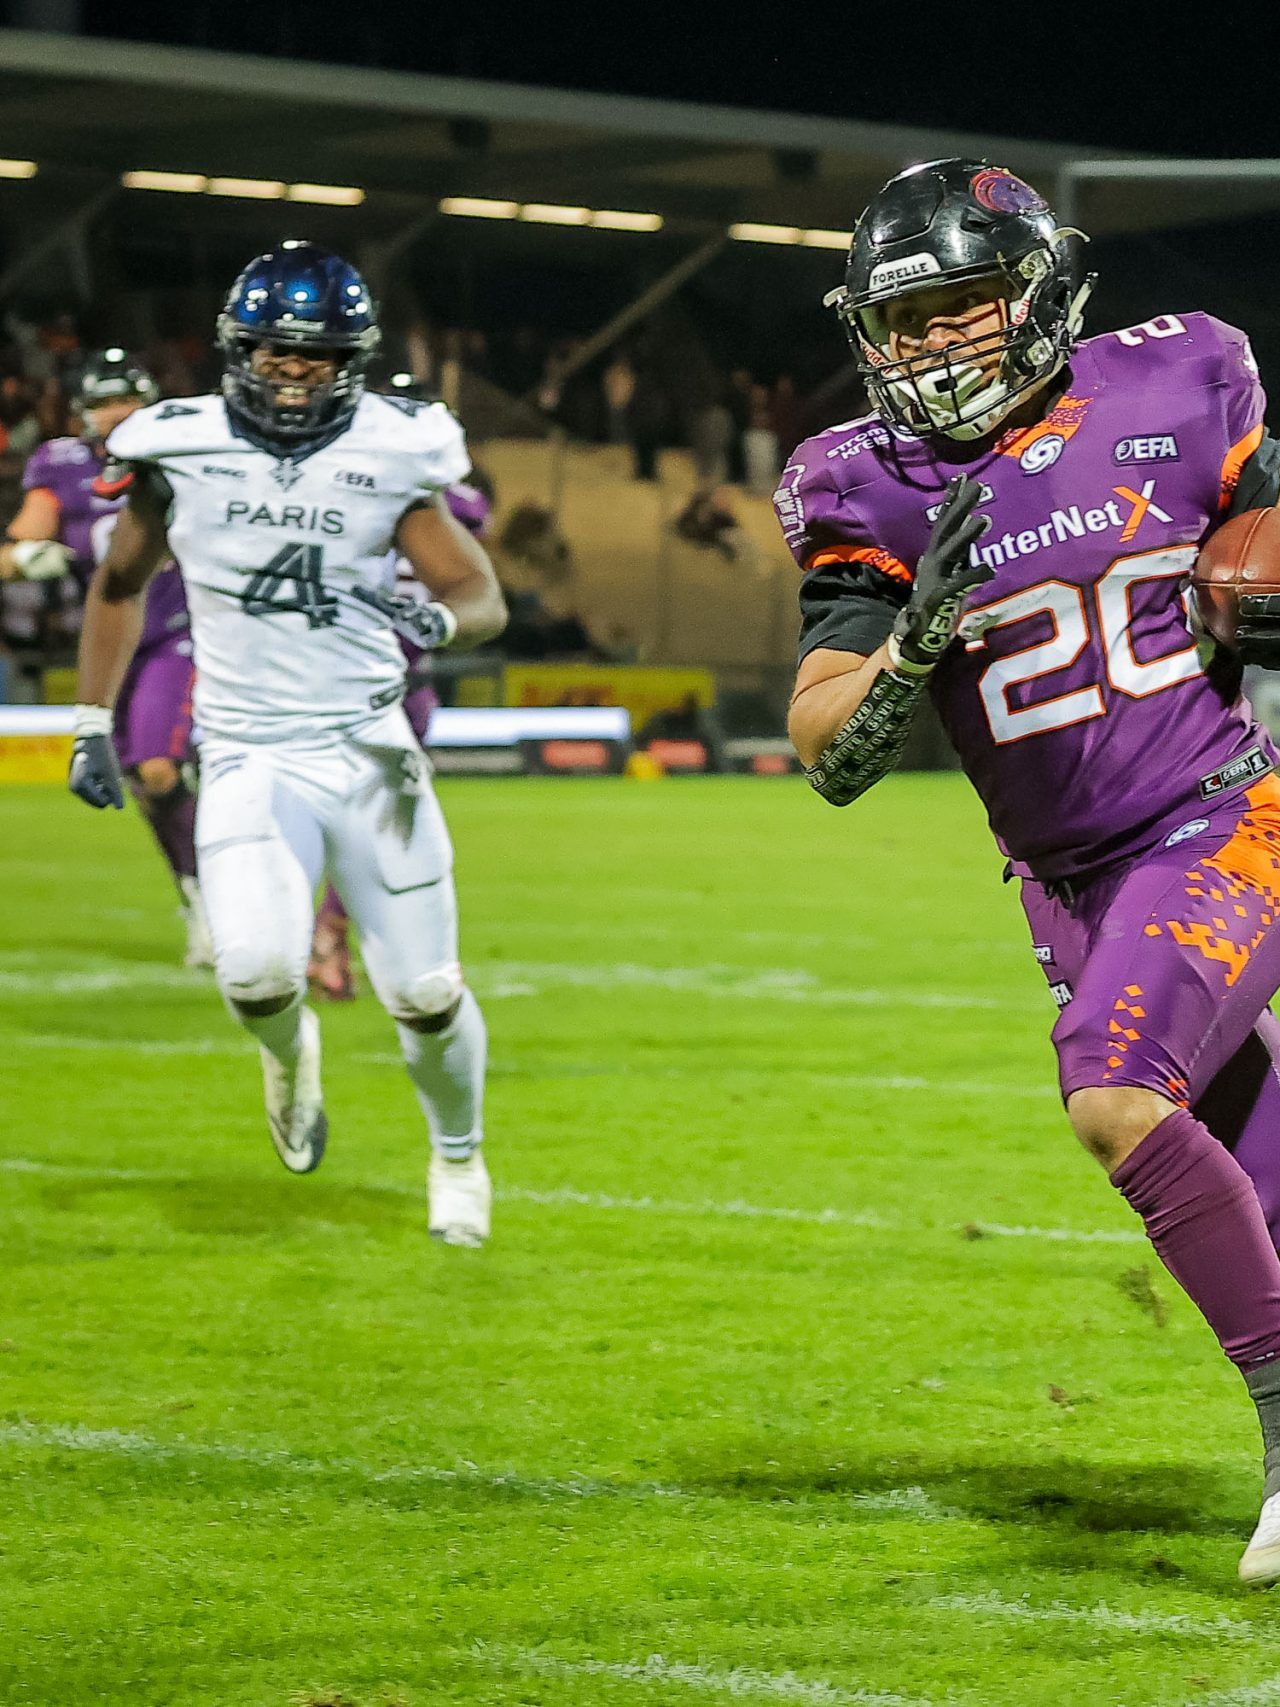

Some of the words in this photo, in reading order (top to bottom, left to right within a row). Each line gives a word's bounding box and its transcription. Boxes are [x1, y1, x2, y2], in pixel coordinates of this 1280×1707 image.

[872, 262, 929, 286] FORELLE
[226, 500, 345, 535] PARIS
[969, 479, 1174, 568] InterNetX
[241, 541, 339, 631] 4
